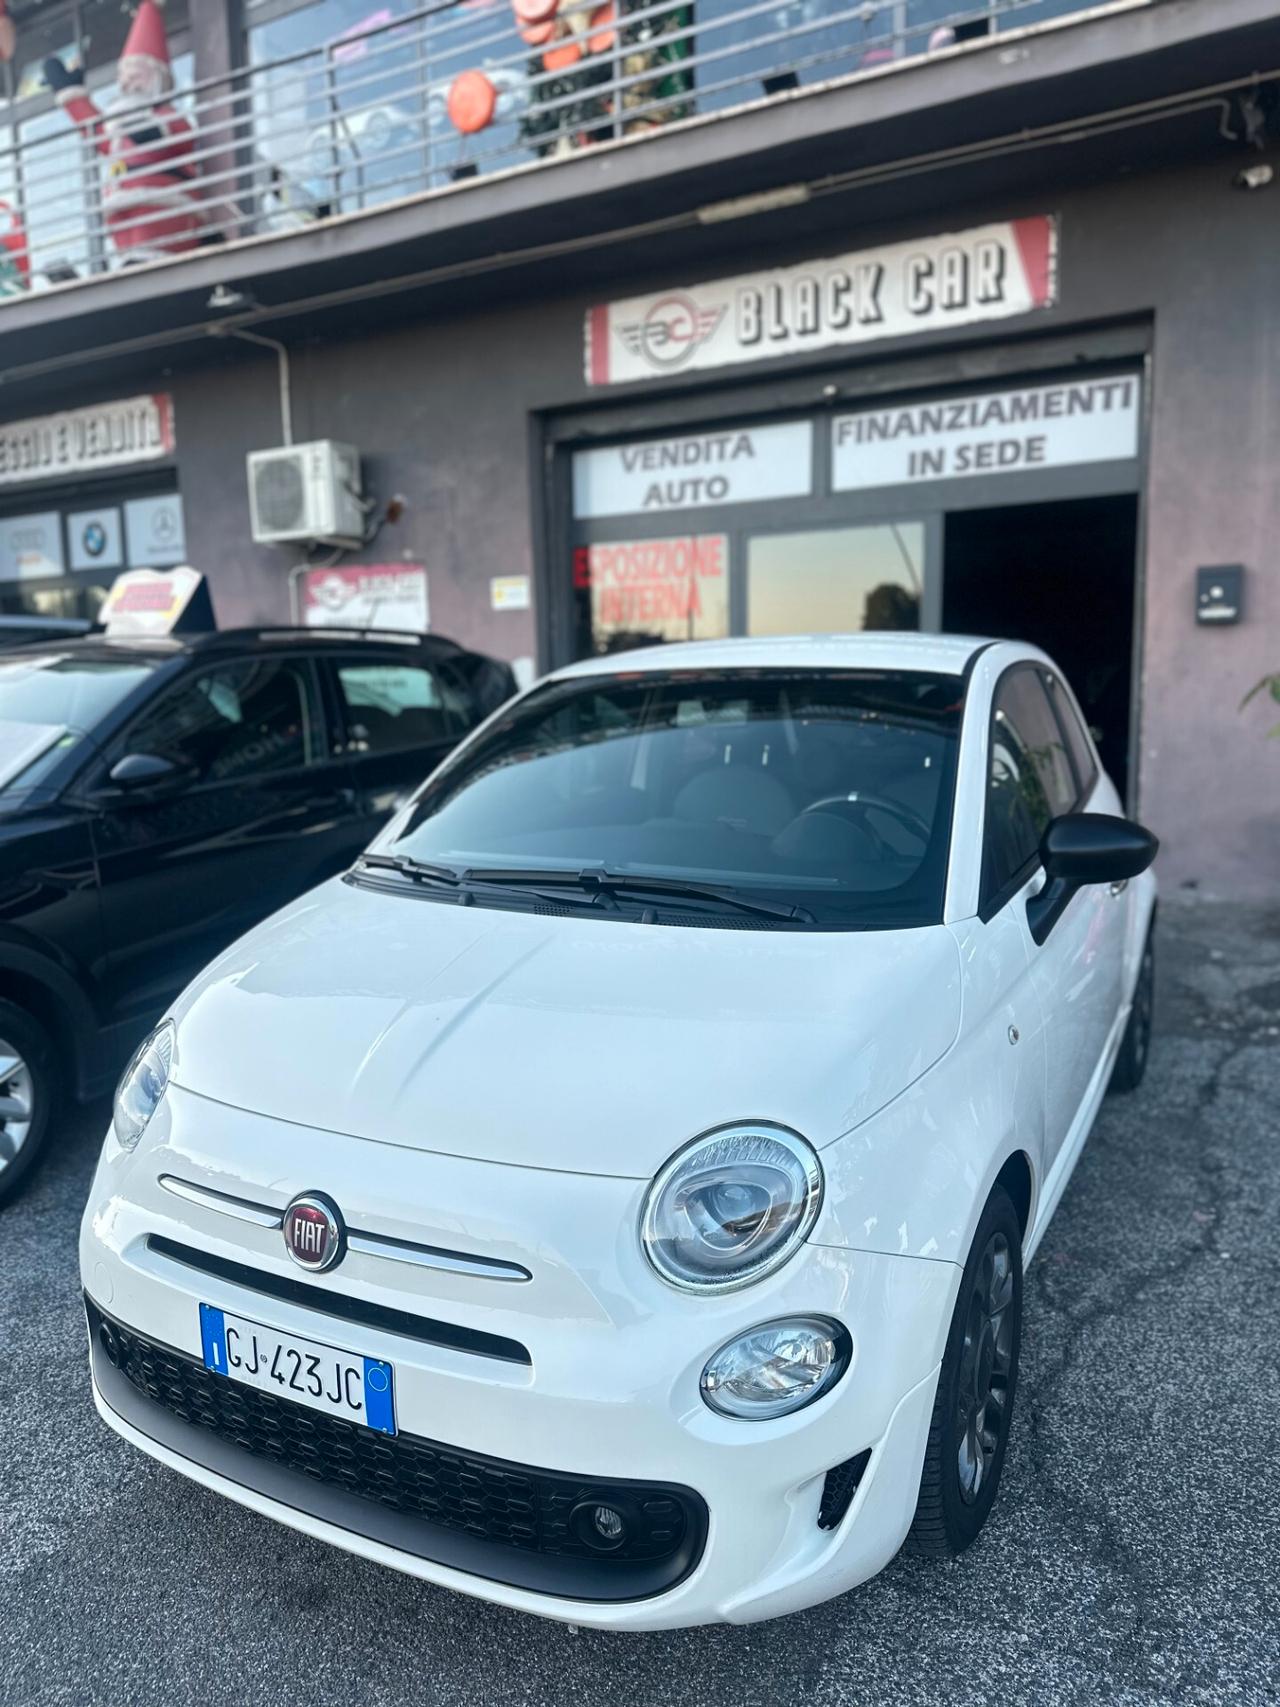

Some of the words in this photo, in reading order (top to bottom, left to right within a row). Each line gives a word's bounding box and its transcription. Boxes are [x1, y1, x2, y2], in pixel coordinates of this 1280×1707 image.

[736, 263, 884, 346] BLACK
[904, 239, 1007, 315] CAR
[837, 381, 1134, 446] FINANZIAMENTI
[620, 434, 755, 474] VENDITA
[907, 447, 945, 478] IN
[954, 435, 1048, 472] SEDE
[642, 476, 730, 507] AUTO
[573, 535, 723, 589] ESPOSIZIONE
[598, 576, 703, 624] INTERNA
[293, 1217, 325, 1254] FIAT
